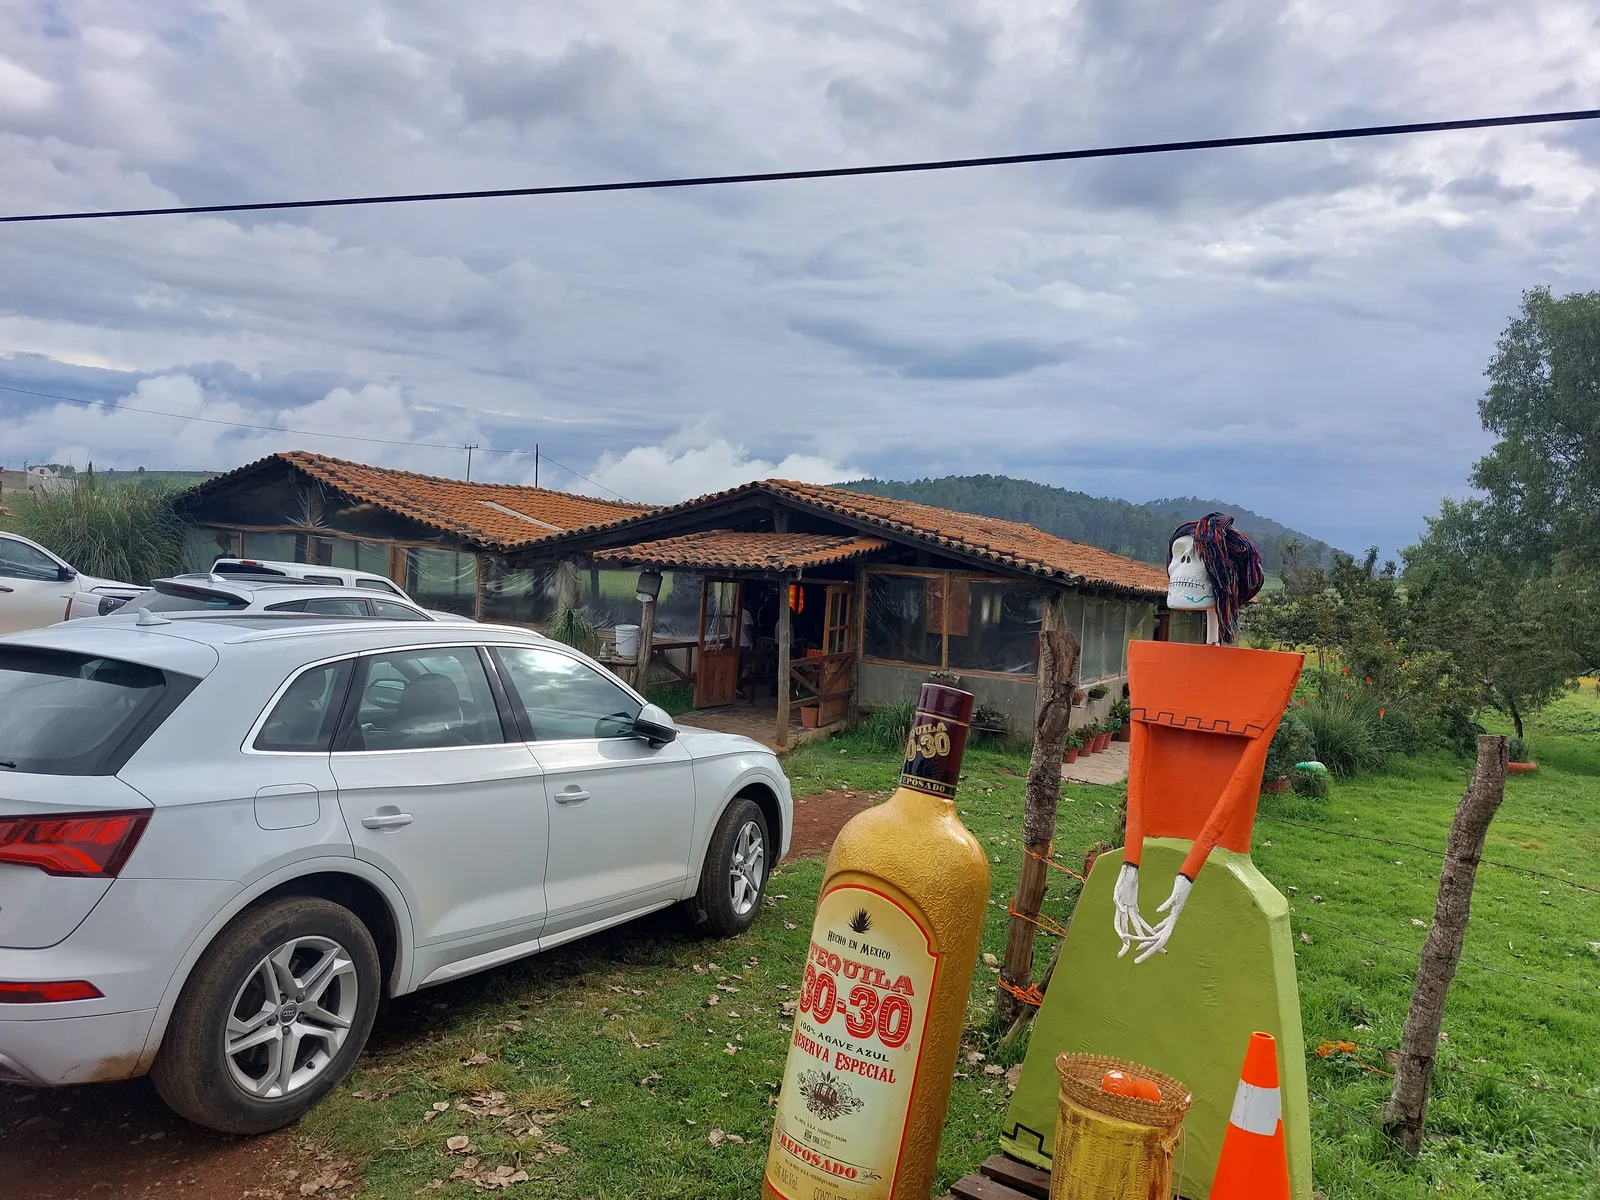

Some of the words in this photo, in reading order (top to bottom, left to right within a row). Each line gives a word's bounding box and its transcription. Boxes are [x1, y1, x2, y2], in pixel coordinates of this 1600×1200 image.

[810, 940, 915, 996] TEQUILA
[848, 939, 858, 951] EN
[860, 943, 891, 960] MEXICO
[800, 962, 913, 1049] 30-30
[793, 1028, 830, 1063] RESERVA
[834, 1051, 896, 1084] ESPECIAL
[817, 1032, 854, 1052] AGAVE
[856, 1047, 890, 1063] AZUL
[780, 1133, 858, 1179] REPOSADO
